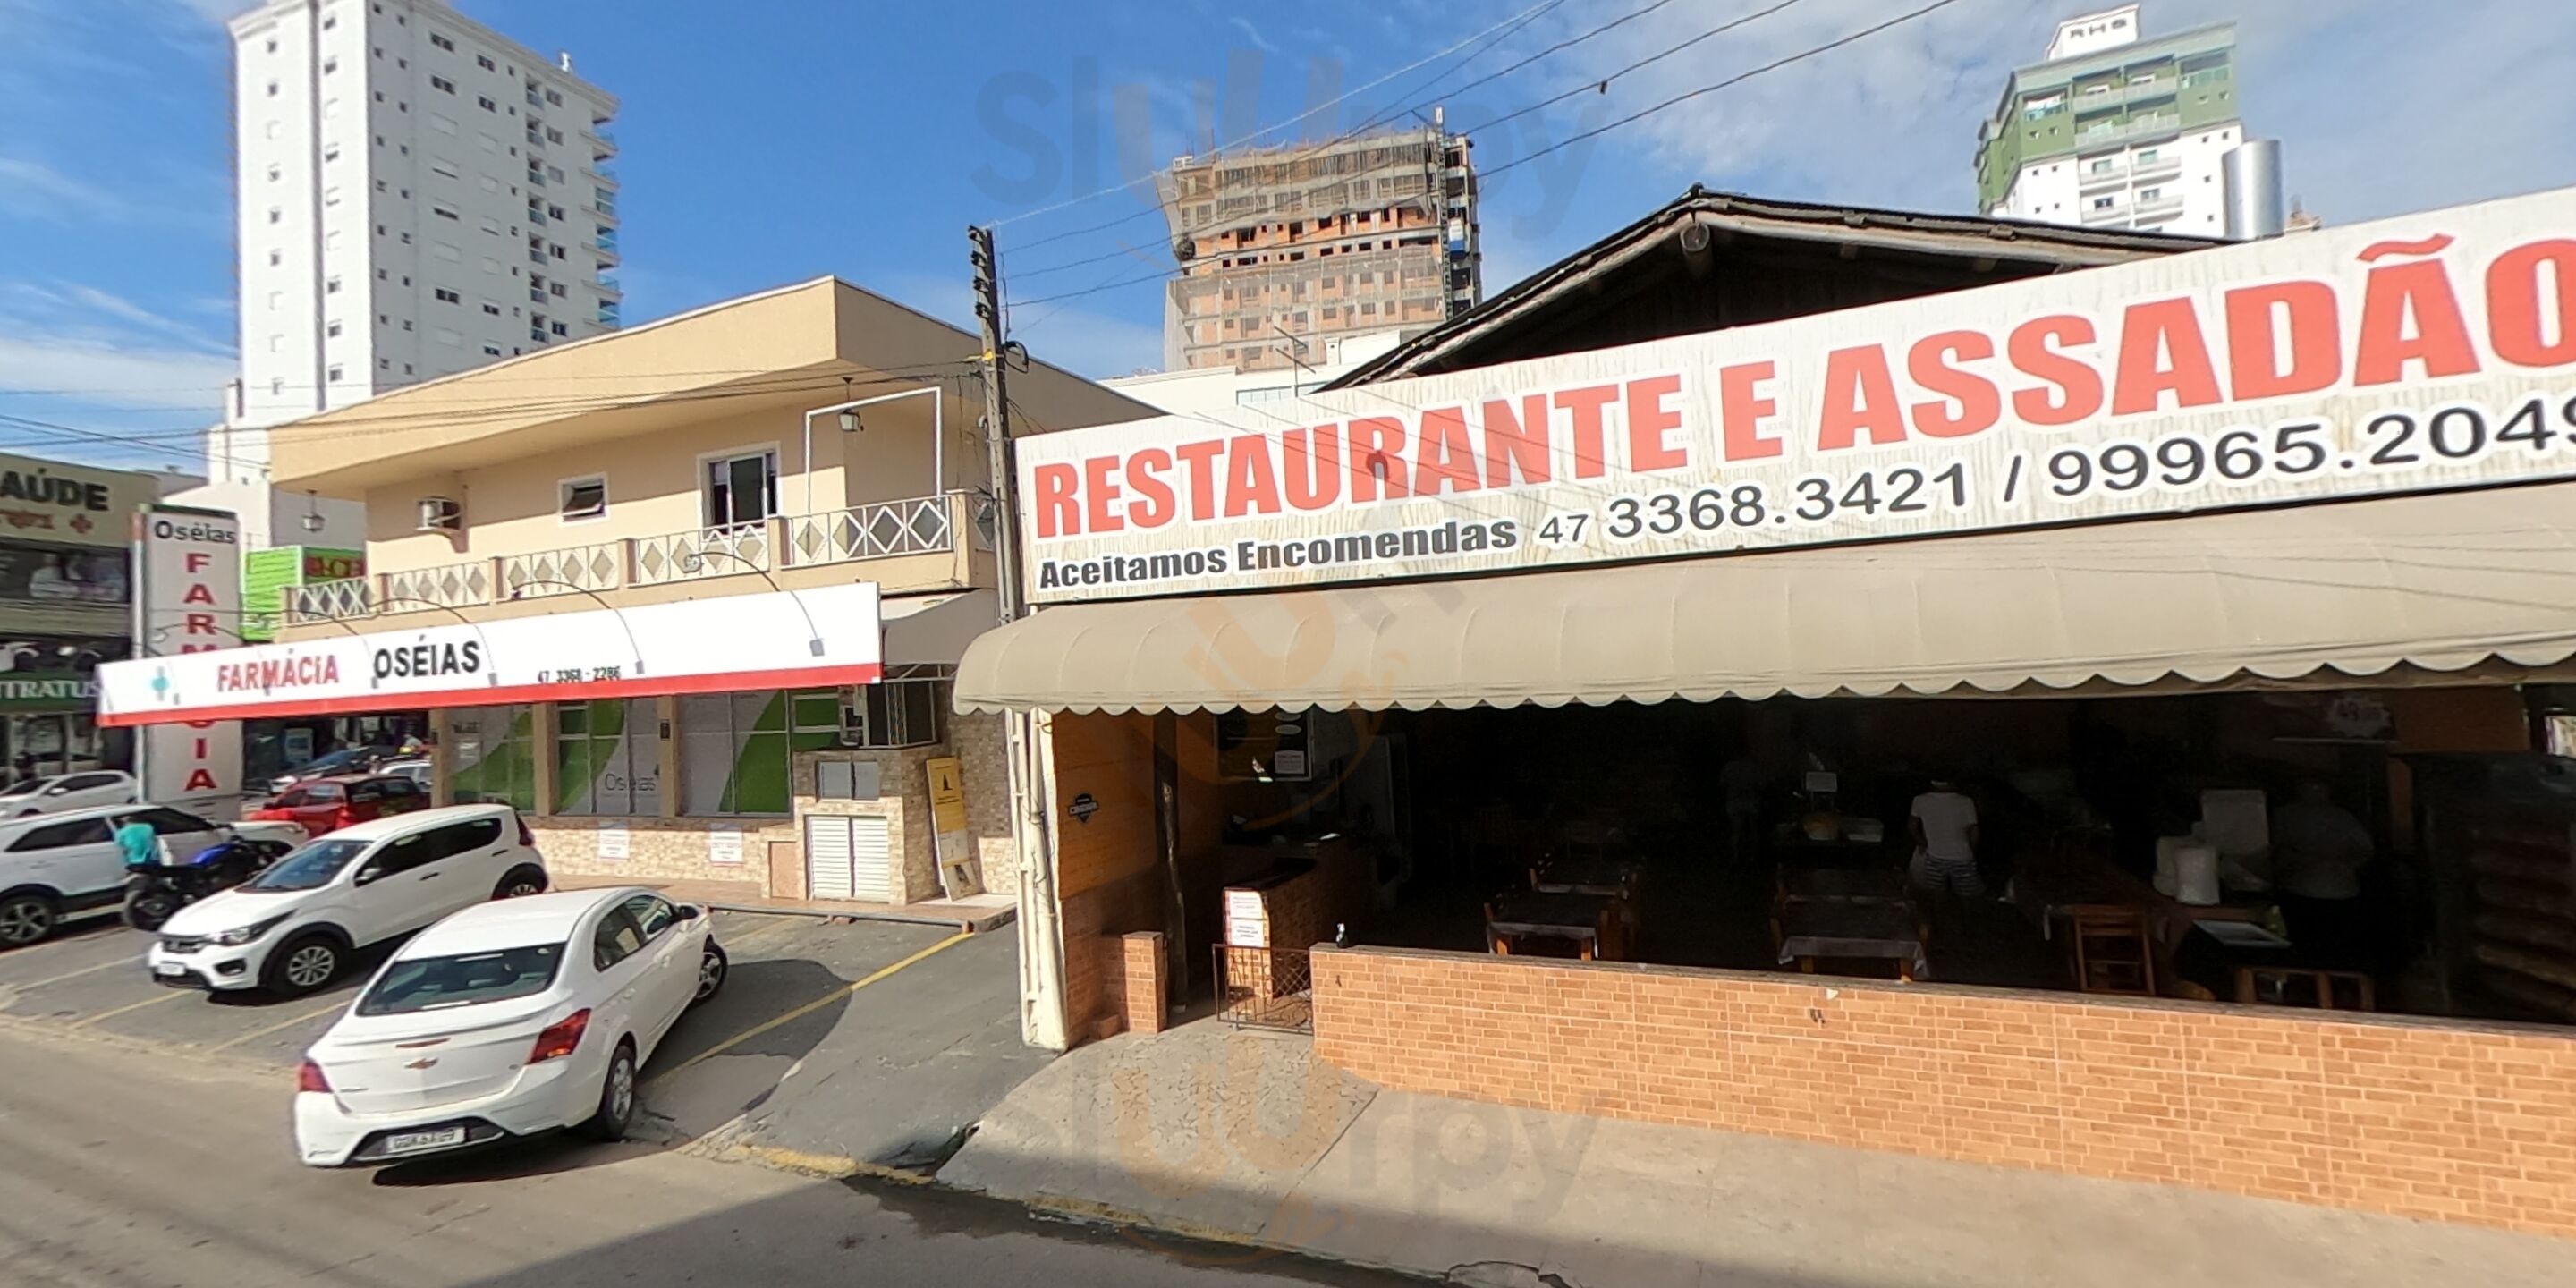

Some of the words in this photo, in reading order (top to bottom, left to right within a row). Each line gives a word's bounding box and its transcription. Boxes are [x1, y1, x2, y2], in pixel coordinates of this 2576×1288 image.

[1035, 374, 1688, 538] RESTAURANTE
[1720, 360, 1783, 462] E
[1817, 233, 2576, 451] ASSADÃO
[1040, 547, 1227, 589] Aceitamos
[1238, 521, 1518, 571] Encomendas
[1539, 513, 1589, 545] 47
[1607, 462, 1966, 538] 3368.3421
[2004, 455, 2021, 503] /
[2048, 397, 2576, 497] 99965.204
[373, 633, 480, 678] OSÉIAS
